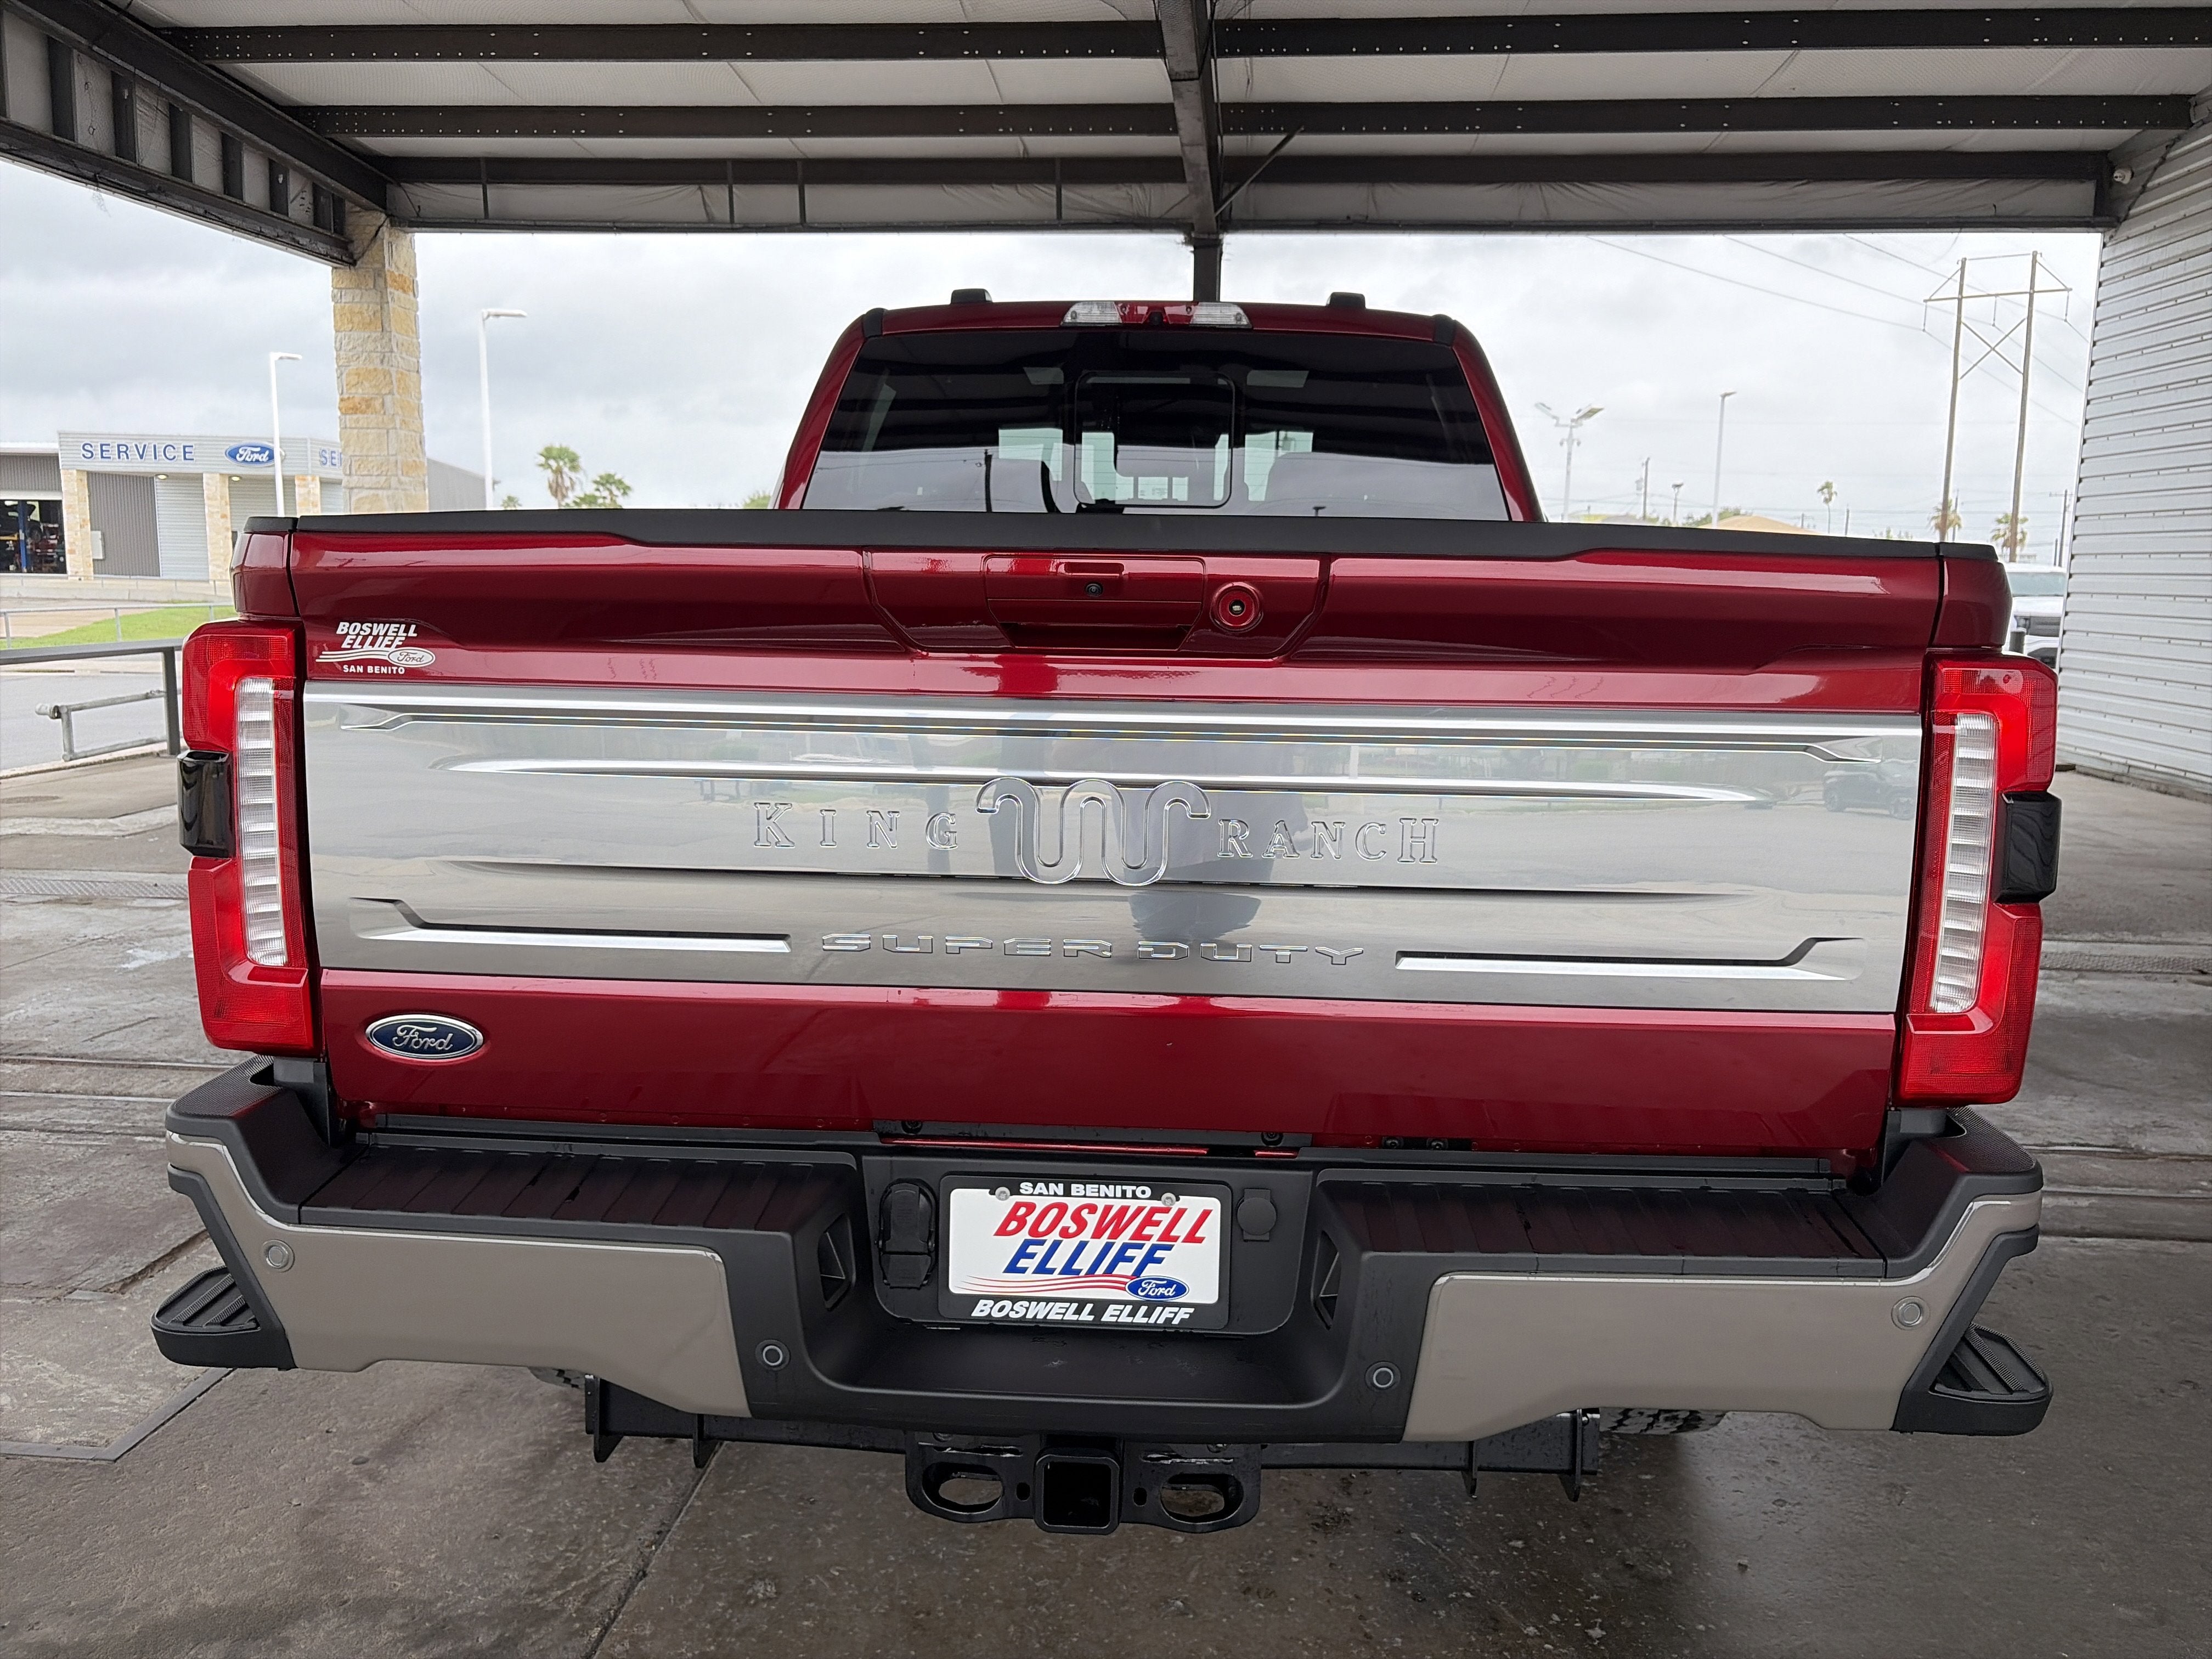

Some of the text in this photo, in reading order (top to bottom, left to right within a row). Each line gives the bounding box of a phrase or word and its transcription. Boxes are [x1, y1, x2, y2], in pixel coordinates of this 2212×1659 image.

[82, 442, 195, 461] SERVICE
[236, 445, 269, 462] Ford
[319, 449, 342, 467] SE
[336, 622, 418, 637] BOSWELL
[341, 635, 406, 649] ELLIFF
[397, 651, 425, 663] Ford
[343, 664, 405, 675] SAN BENITO
[754, 802, 1440, 864] KING RANCH
[822, 933, 1364, 966] SUPER DUTY
[392, 1024, 454, 1051] Ford
[1019, 1182, 1152, 1199] SAN BENITO
[992, 1201, 1214, 1244] BOSWELL
[1002, 1238, 1176, 1277] ELLIFF
[1137, 1279, 1177, 1296] Ford
[970, 1299, 1195, 1325] BOSWELL ELLIFF
